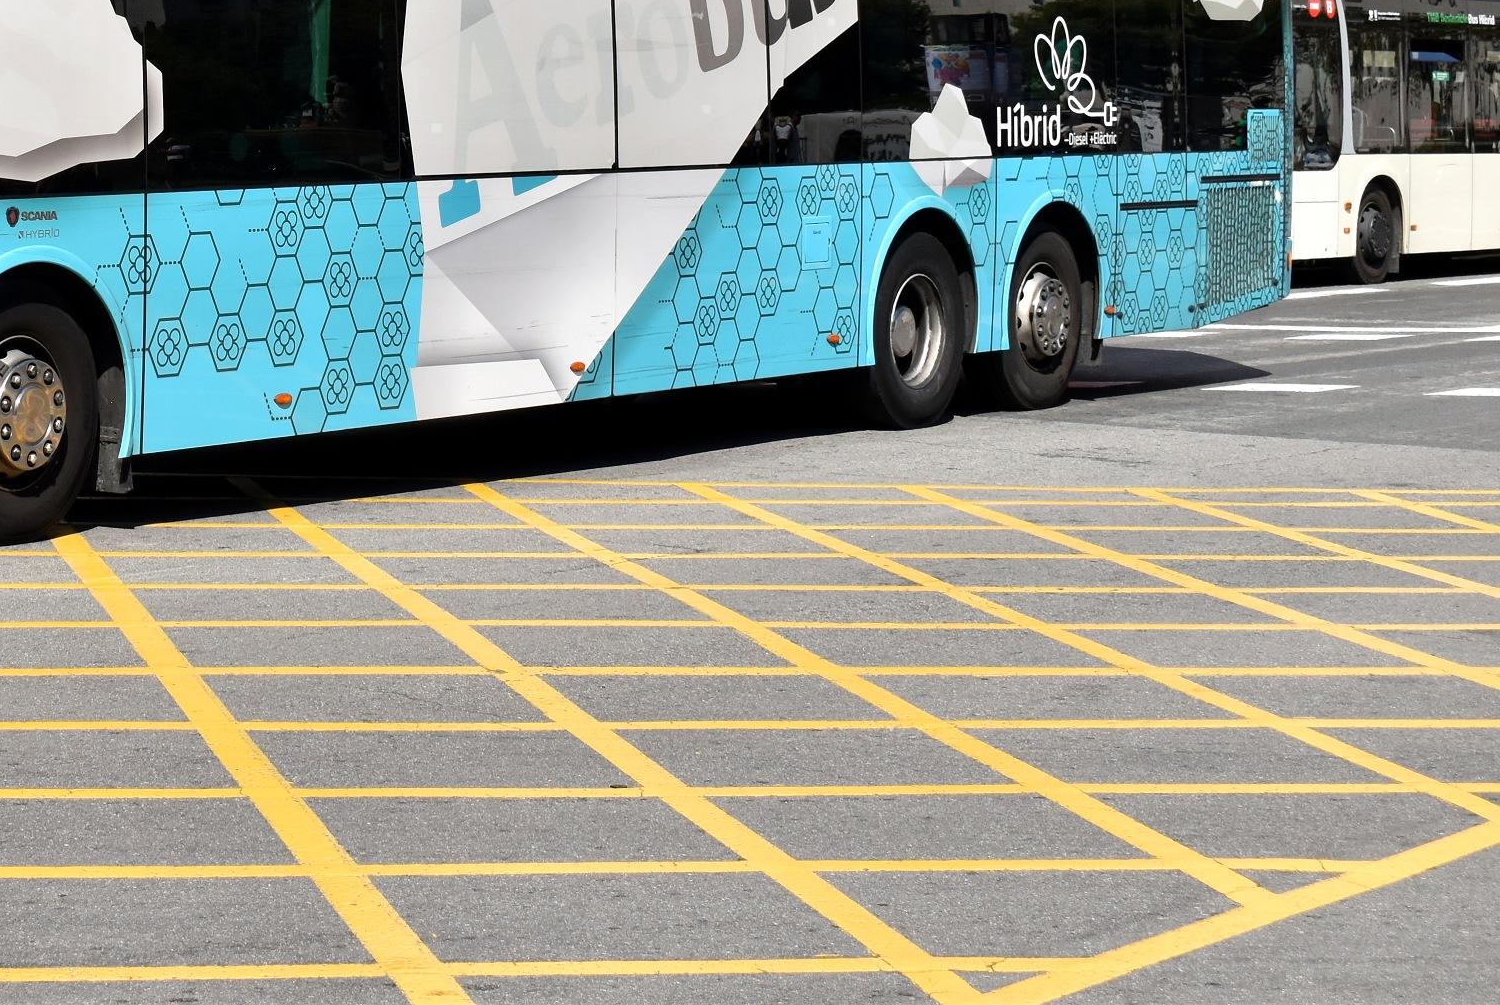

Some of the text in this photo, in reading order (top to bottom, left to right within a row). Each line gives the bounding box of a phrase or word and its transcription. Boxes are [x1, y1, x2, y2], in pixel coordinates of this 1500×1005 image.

[996, 102, 1060, 147] Híbrid
[21, 211, 58, 221] SCANIA
[26, 228, 60, 239] HYBRID
